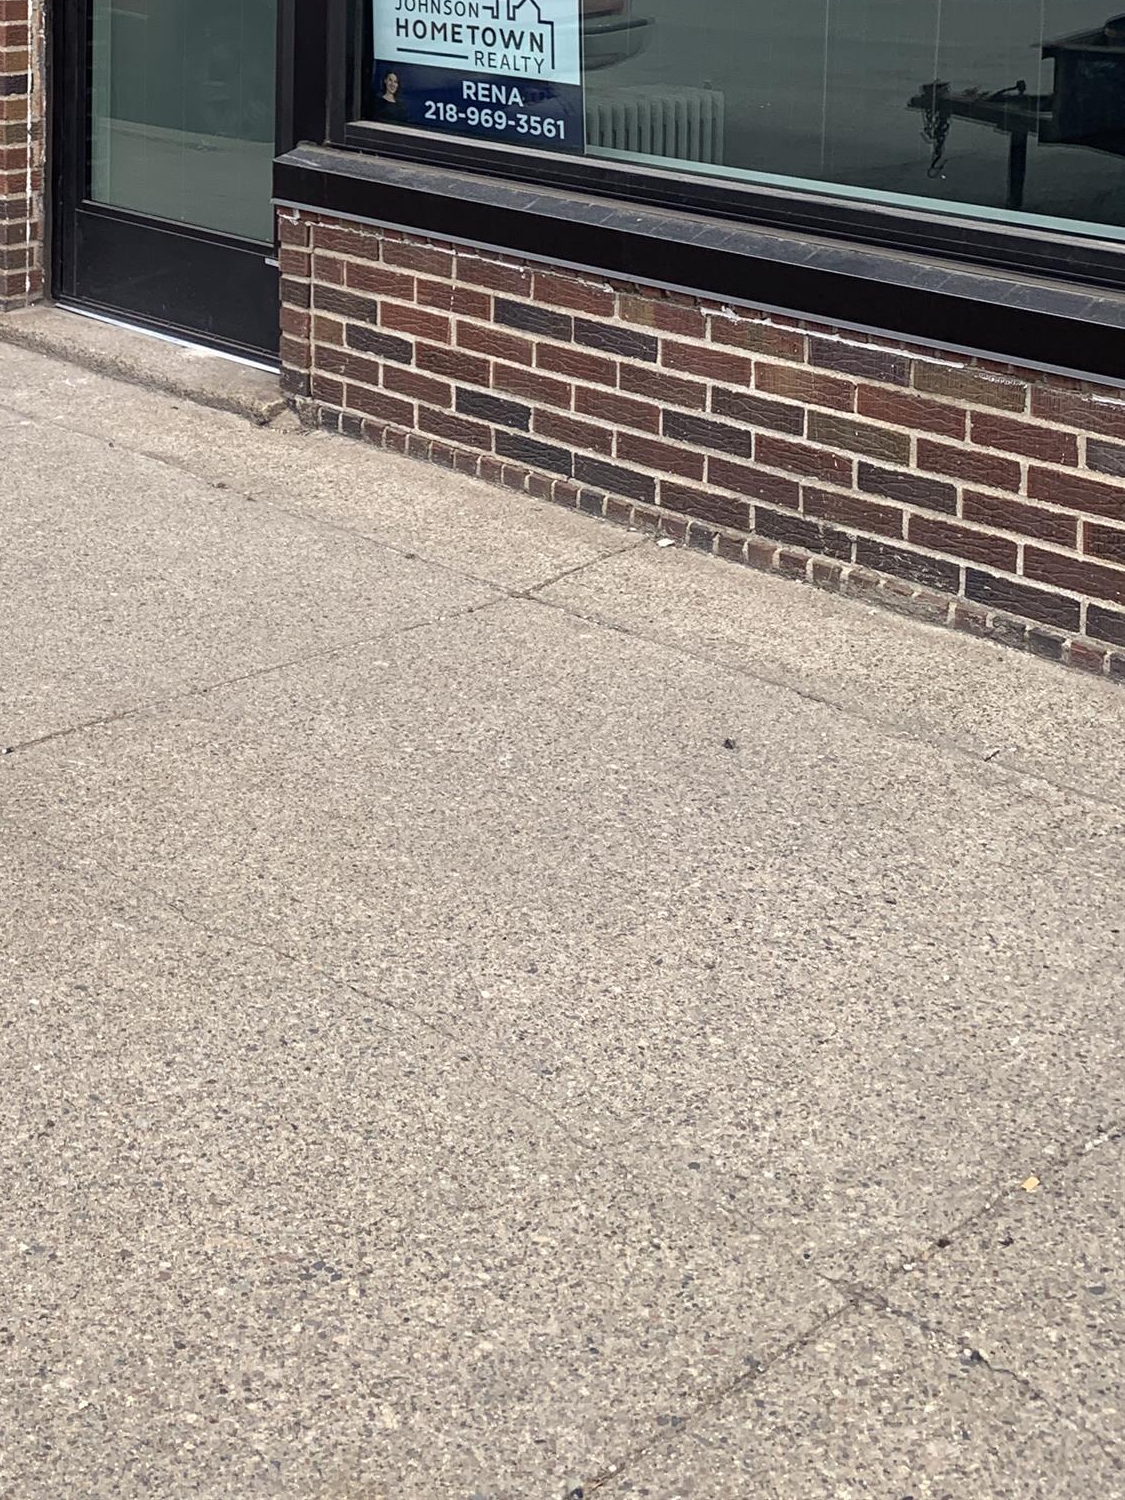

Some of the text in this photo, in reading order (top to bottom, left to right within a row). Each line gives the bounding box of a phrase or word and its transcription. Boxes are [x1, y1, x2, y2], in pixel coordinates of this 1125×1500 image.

[396, 18, 544, 53] HOMETOWN
[475, 50, 545, 74] REALTY
[462, 80, 524, 107] RENA
[424, 100, 565, 139] 218-969-3561
